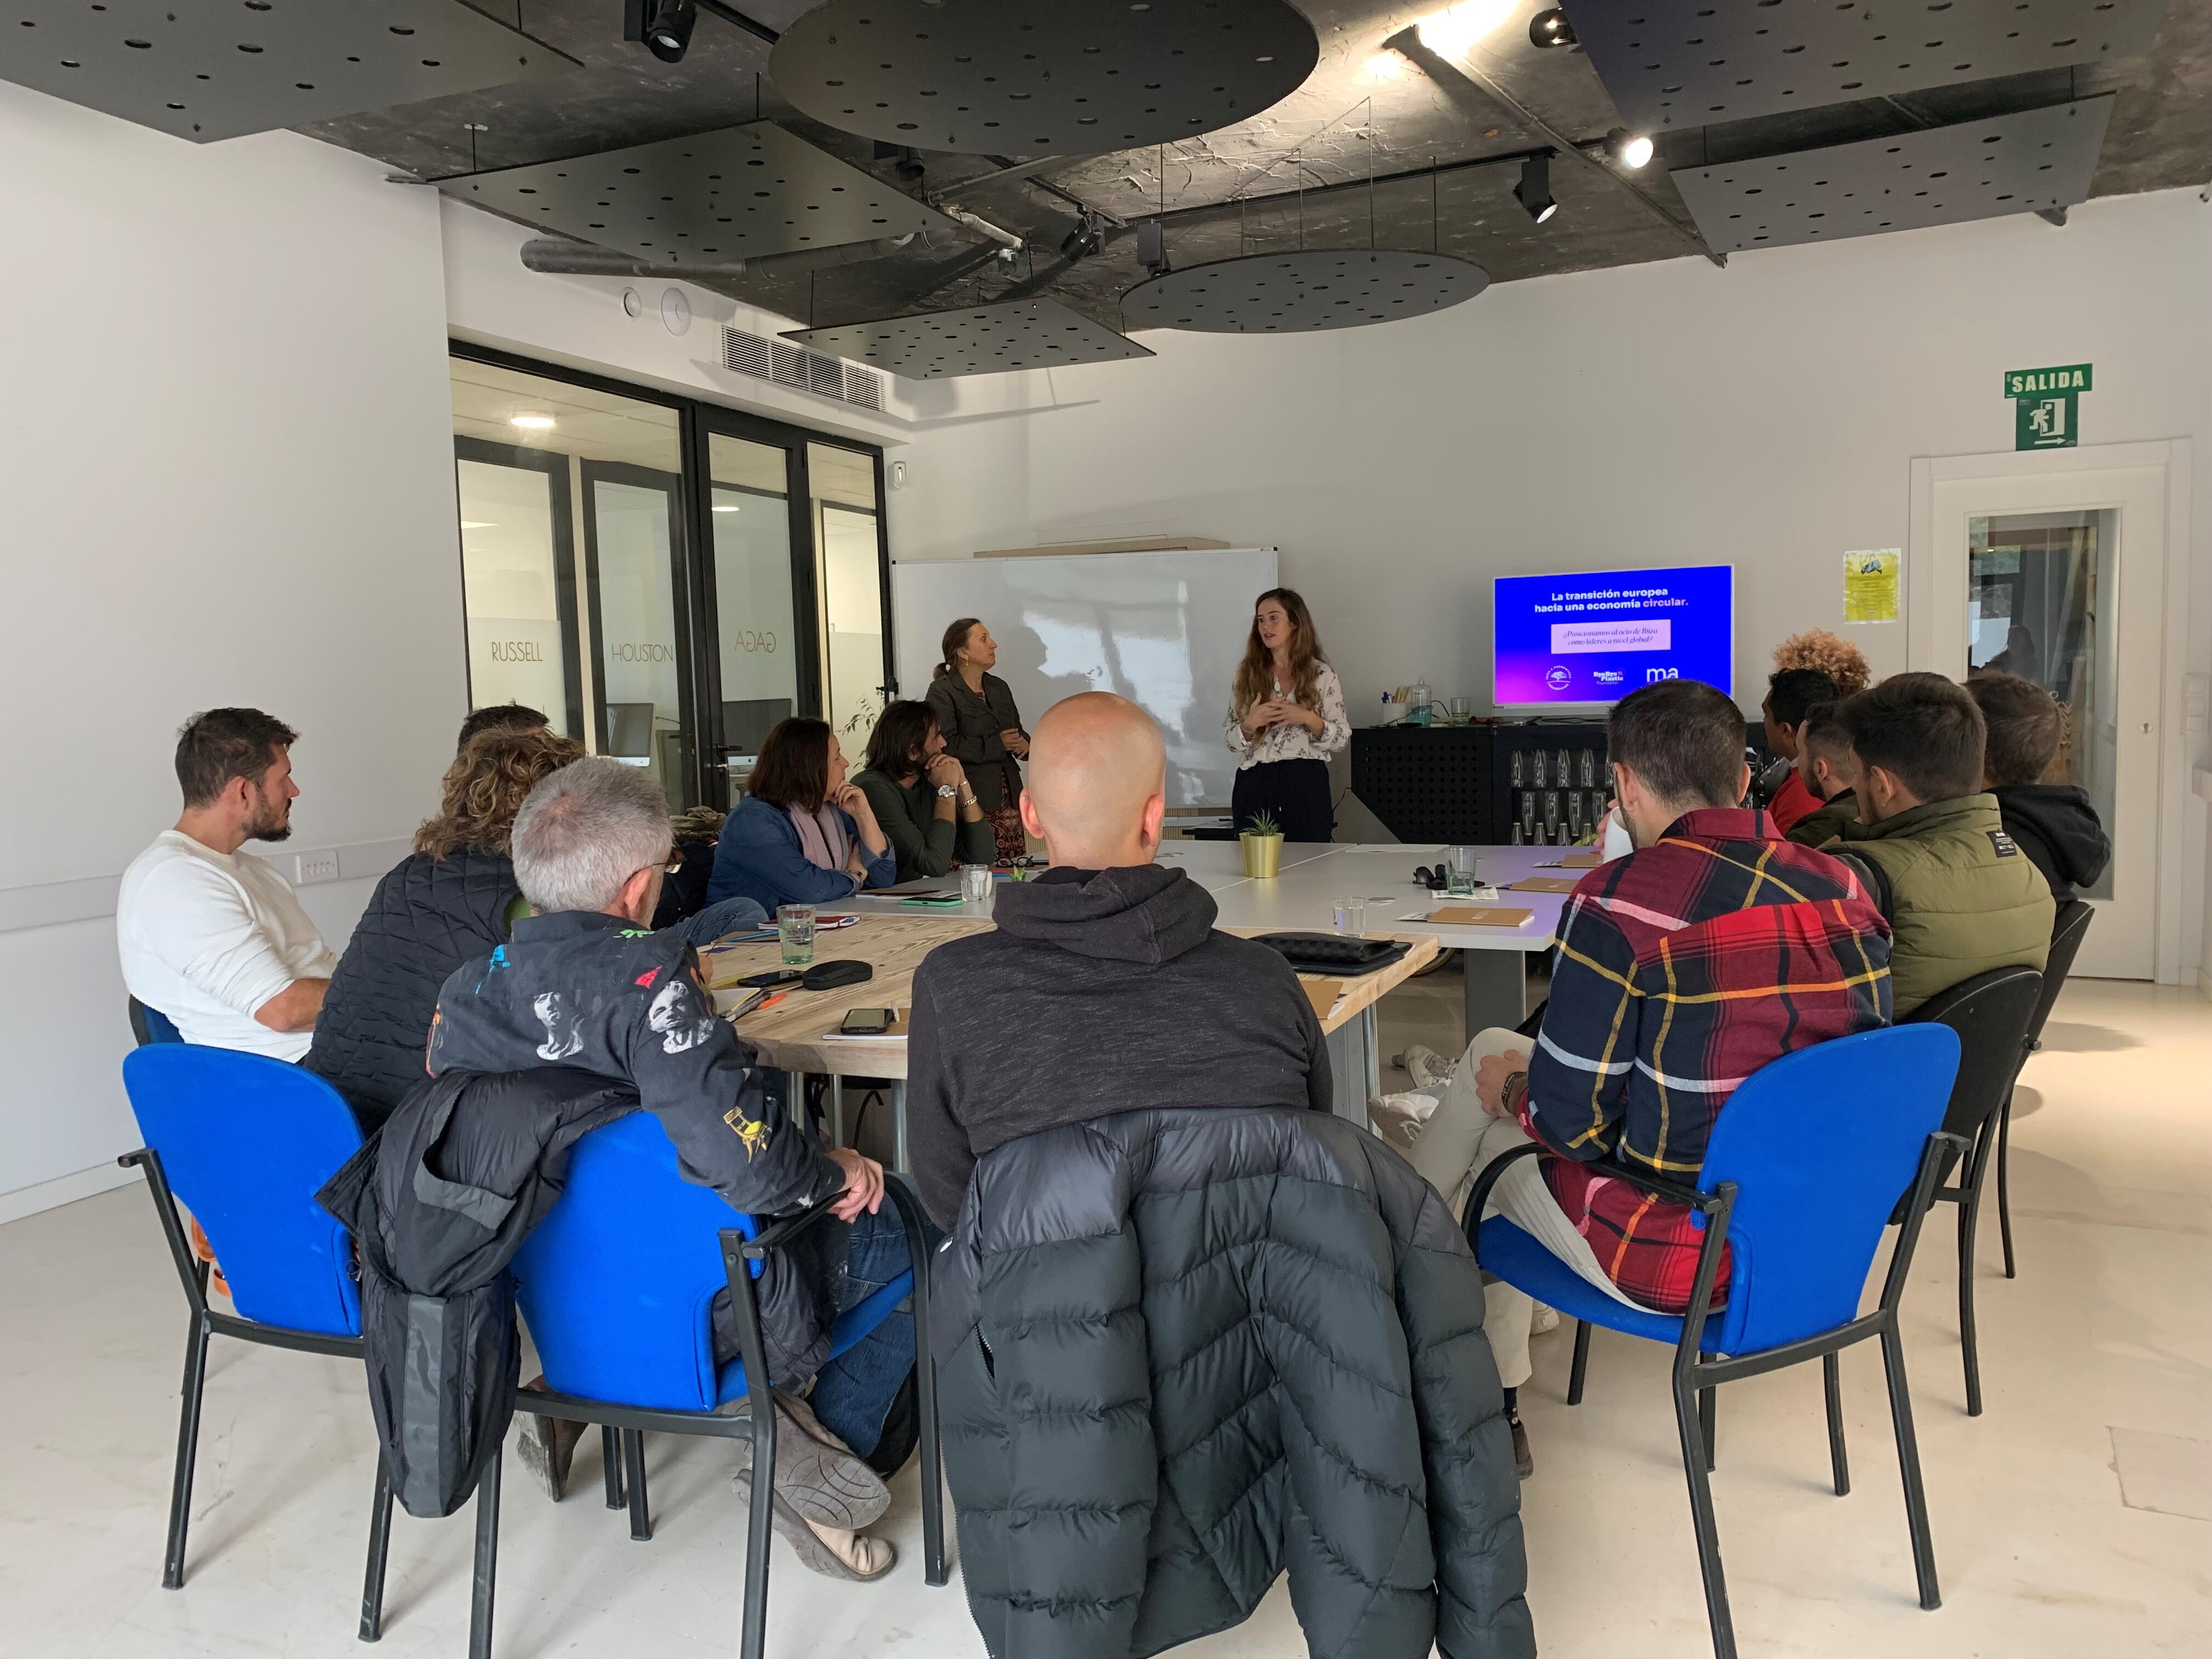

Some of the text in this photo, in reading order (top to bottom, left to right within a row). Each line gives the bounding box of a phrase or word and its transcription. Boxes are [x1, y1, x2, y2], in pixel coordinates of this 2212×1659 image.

[2012, 370, 2084, 393] SALIDA
[1551, 589, 1668, 601] La transición europea
[1534, 597, 1689, 613] hacia una economía circular.
[1629, 636, 1654, 645] global?
[491, 641, 544, 662] RUSSELL
[611, 643, 674, 662] HOUSTON
[1646, 667, 1679, 682] ma
